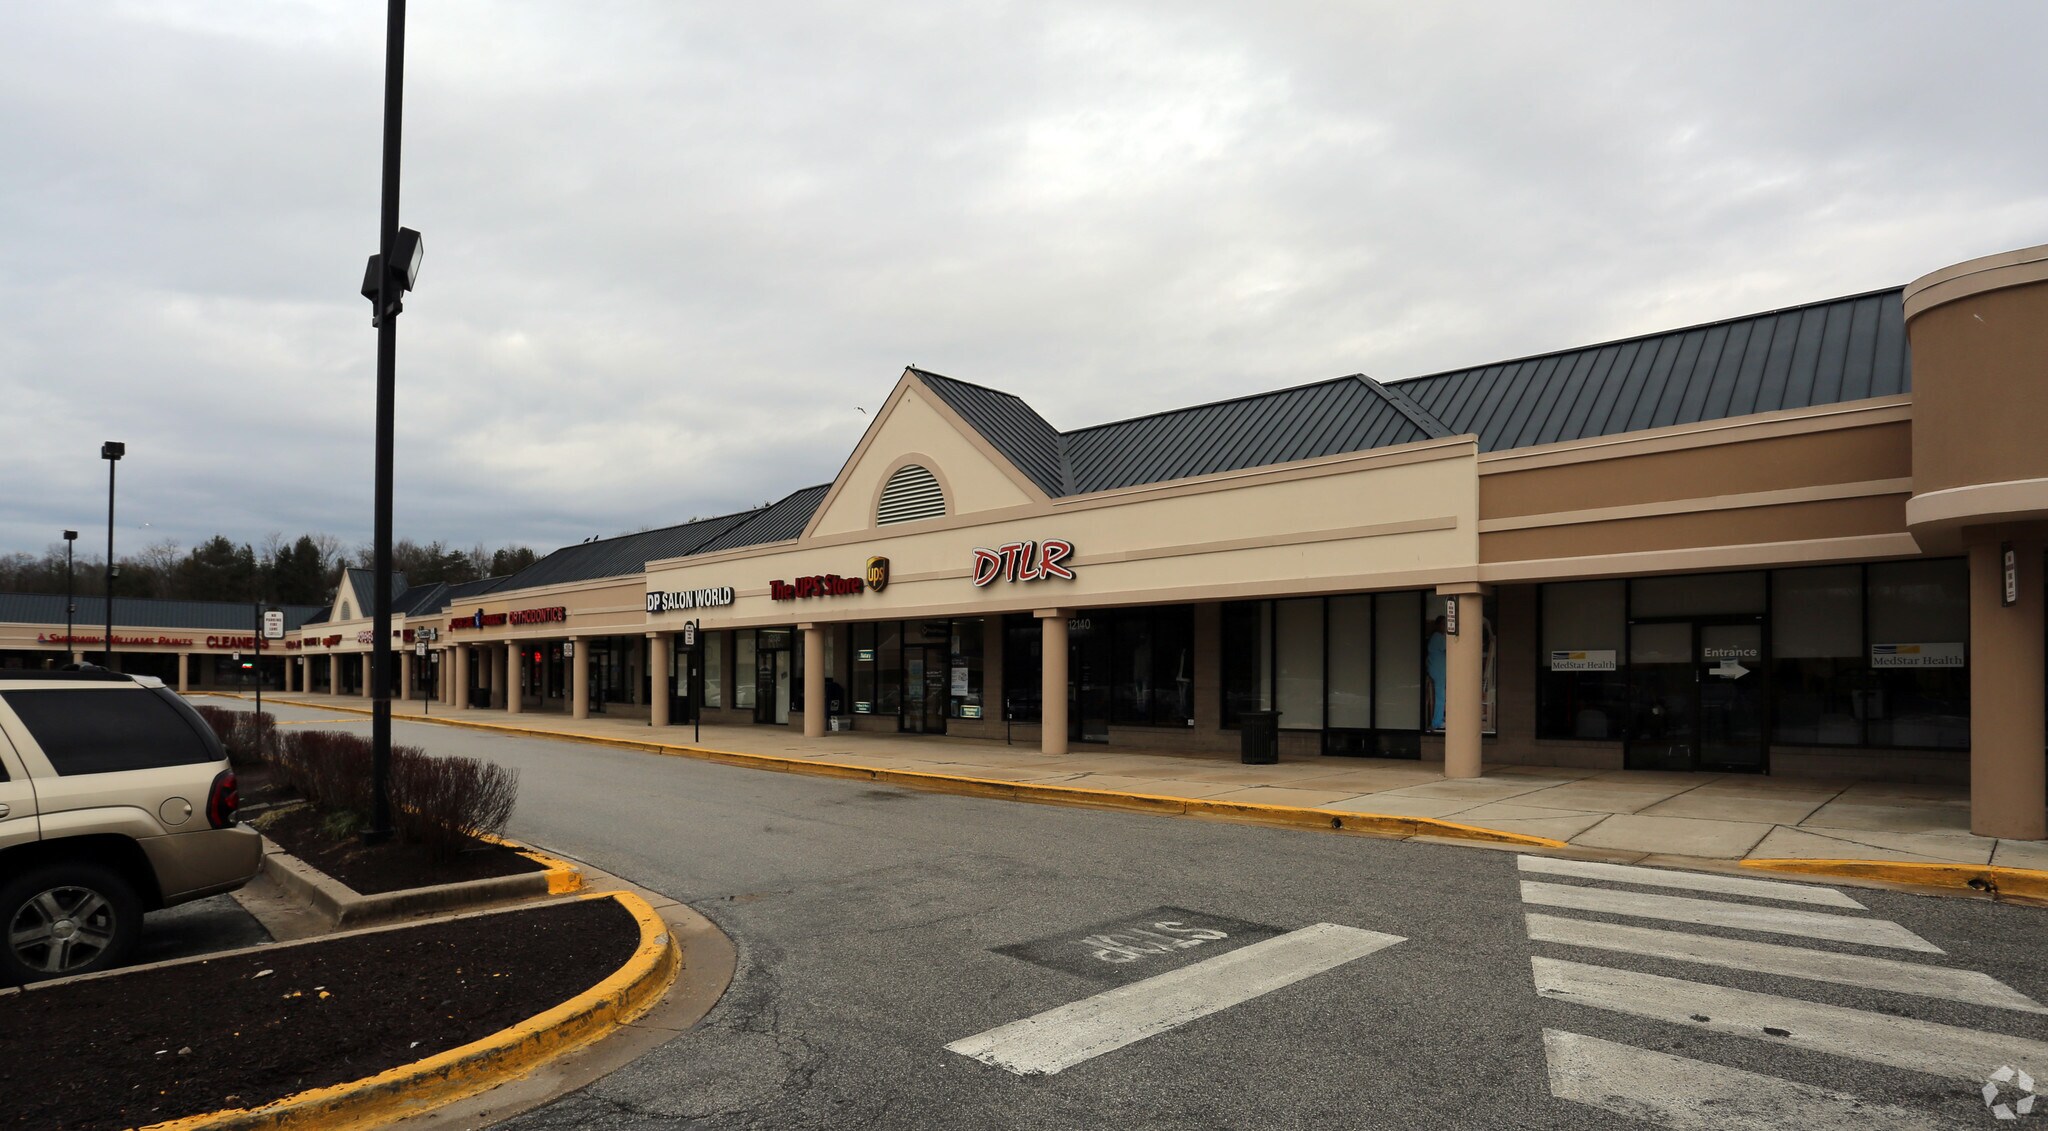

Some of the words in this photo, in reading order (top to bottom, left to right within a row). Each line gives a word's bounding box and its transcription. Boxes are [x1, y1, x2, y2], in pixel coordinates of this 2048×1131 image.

[971, 539, 1076, 587] DTLR
[769, 580, 791, 601] The
[794, 575, 823, 599] UPS
[824, 573, 862, 596] Store
[646, 593, 661, 612] DP
[661, 590, 693, 611] SALON
[695, 586, 732, 608] WORLD
[509, 607, 564, 625] ORTHODONTICS
[1067, 618, 1092, 630] 12140
[1703, 647, 1758, 658] Entrance
[1552, 660, 1586, 670] MedStar
[1587, 660, 1616, 670] Health
[1873, 656, 1920, 666] MedStar
[1922, 655, 1964, 666] Health
